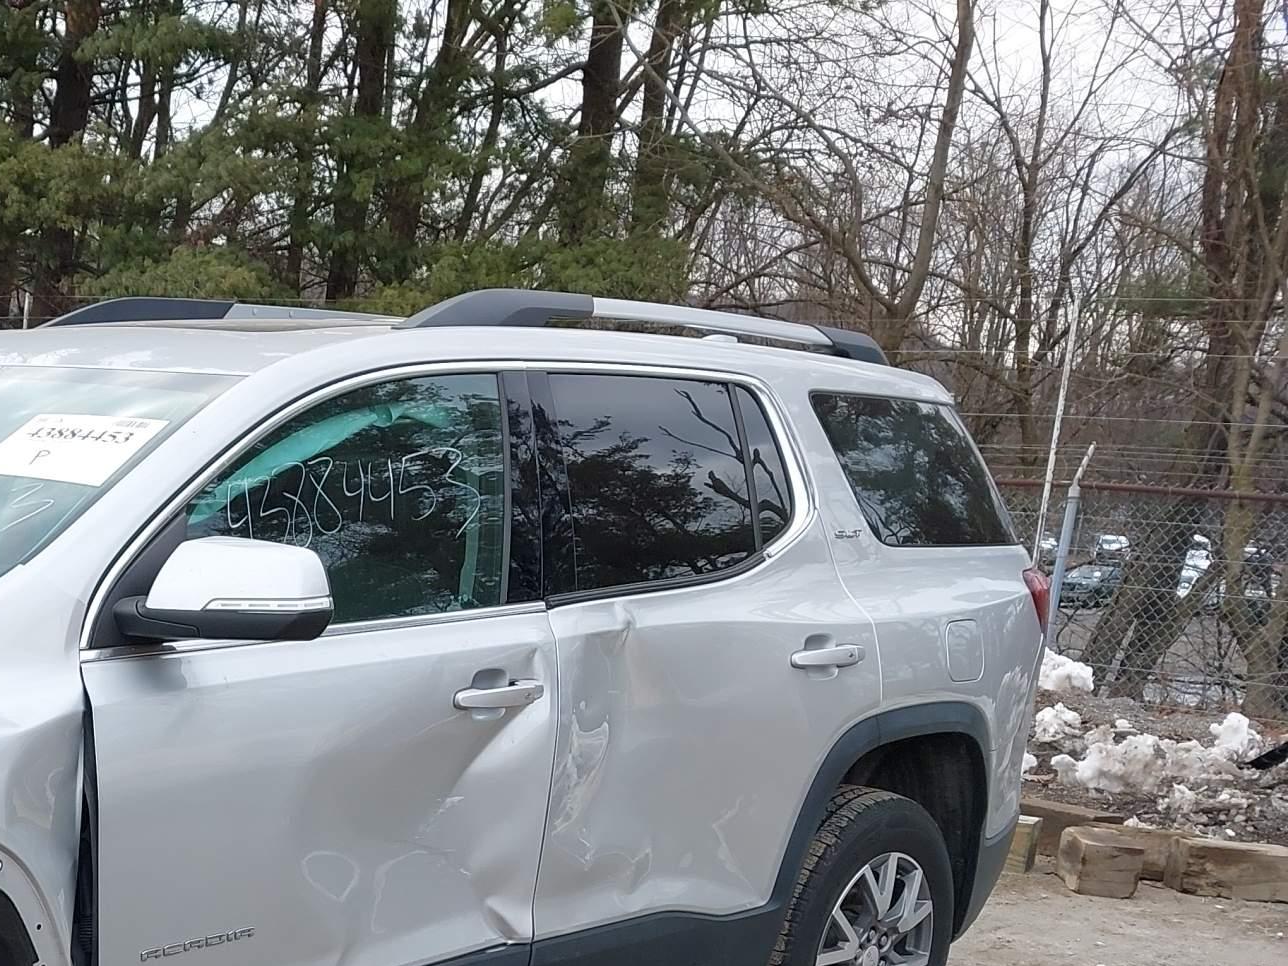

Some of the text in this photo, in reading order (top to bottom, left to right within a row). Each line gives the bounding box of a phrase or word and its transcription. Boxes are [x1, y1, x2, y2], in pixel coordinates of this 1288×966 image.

[26, 427, 135, 445] 43884453
[28, 449, 51, 466] P
[834, 529, 863, 539] SLT
[140, 926, 256, 962] ACADIA
